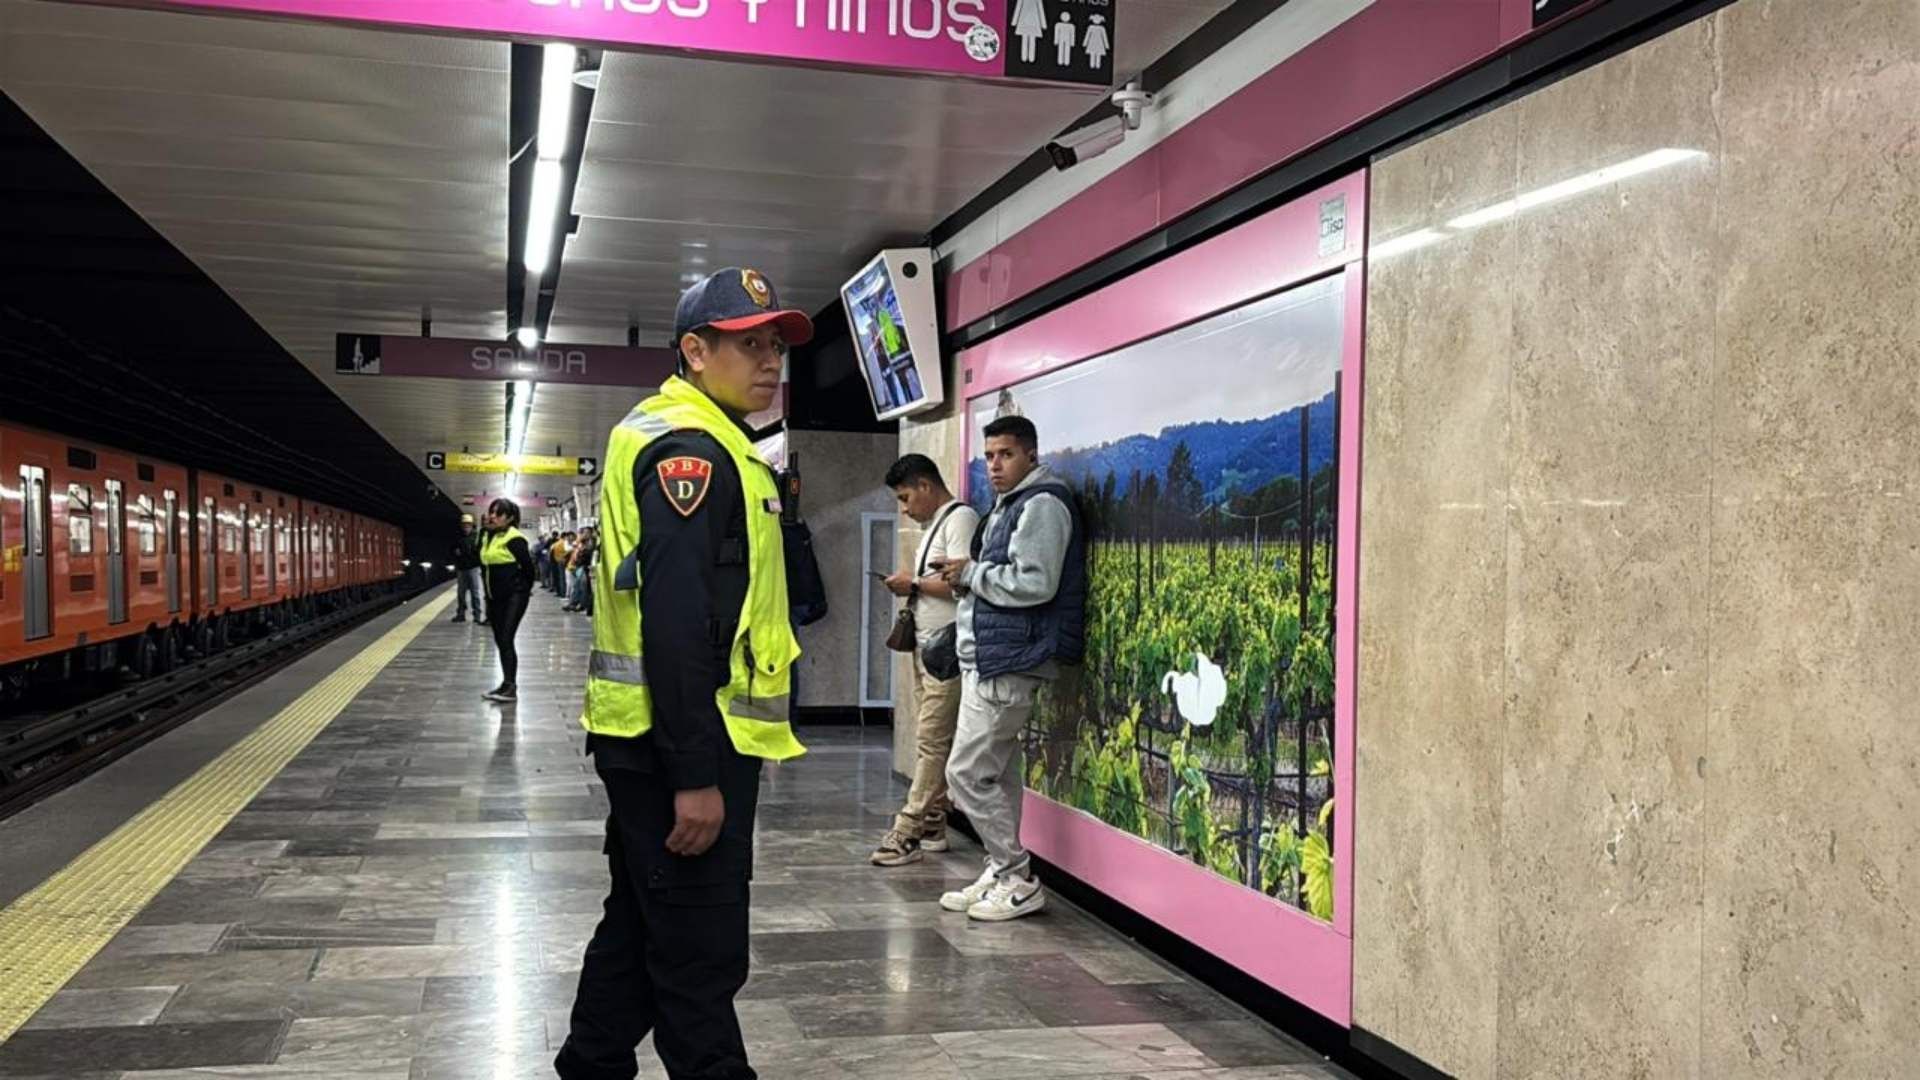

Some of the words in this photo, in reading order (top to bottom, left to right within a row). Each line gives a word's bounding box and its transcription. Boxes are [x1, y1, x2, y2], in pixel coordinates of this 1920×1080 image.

[471, 346, 586, 374] SALIDA
[429, 454, 443, 469] C
[677, 481, 694, 499] D
